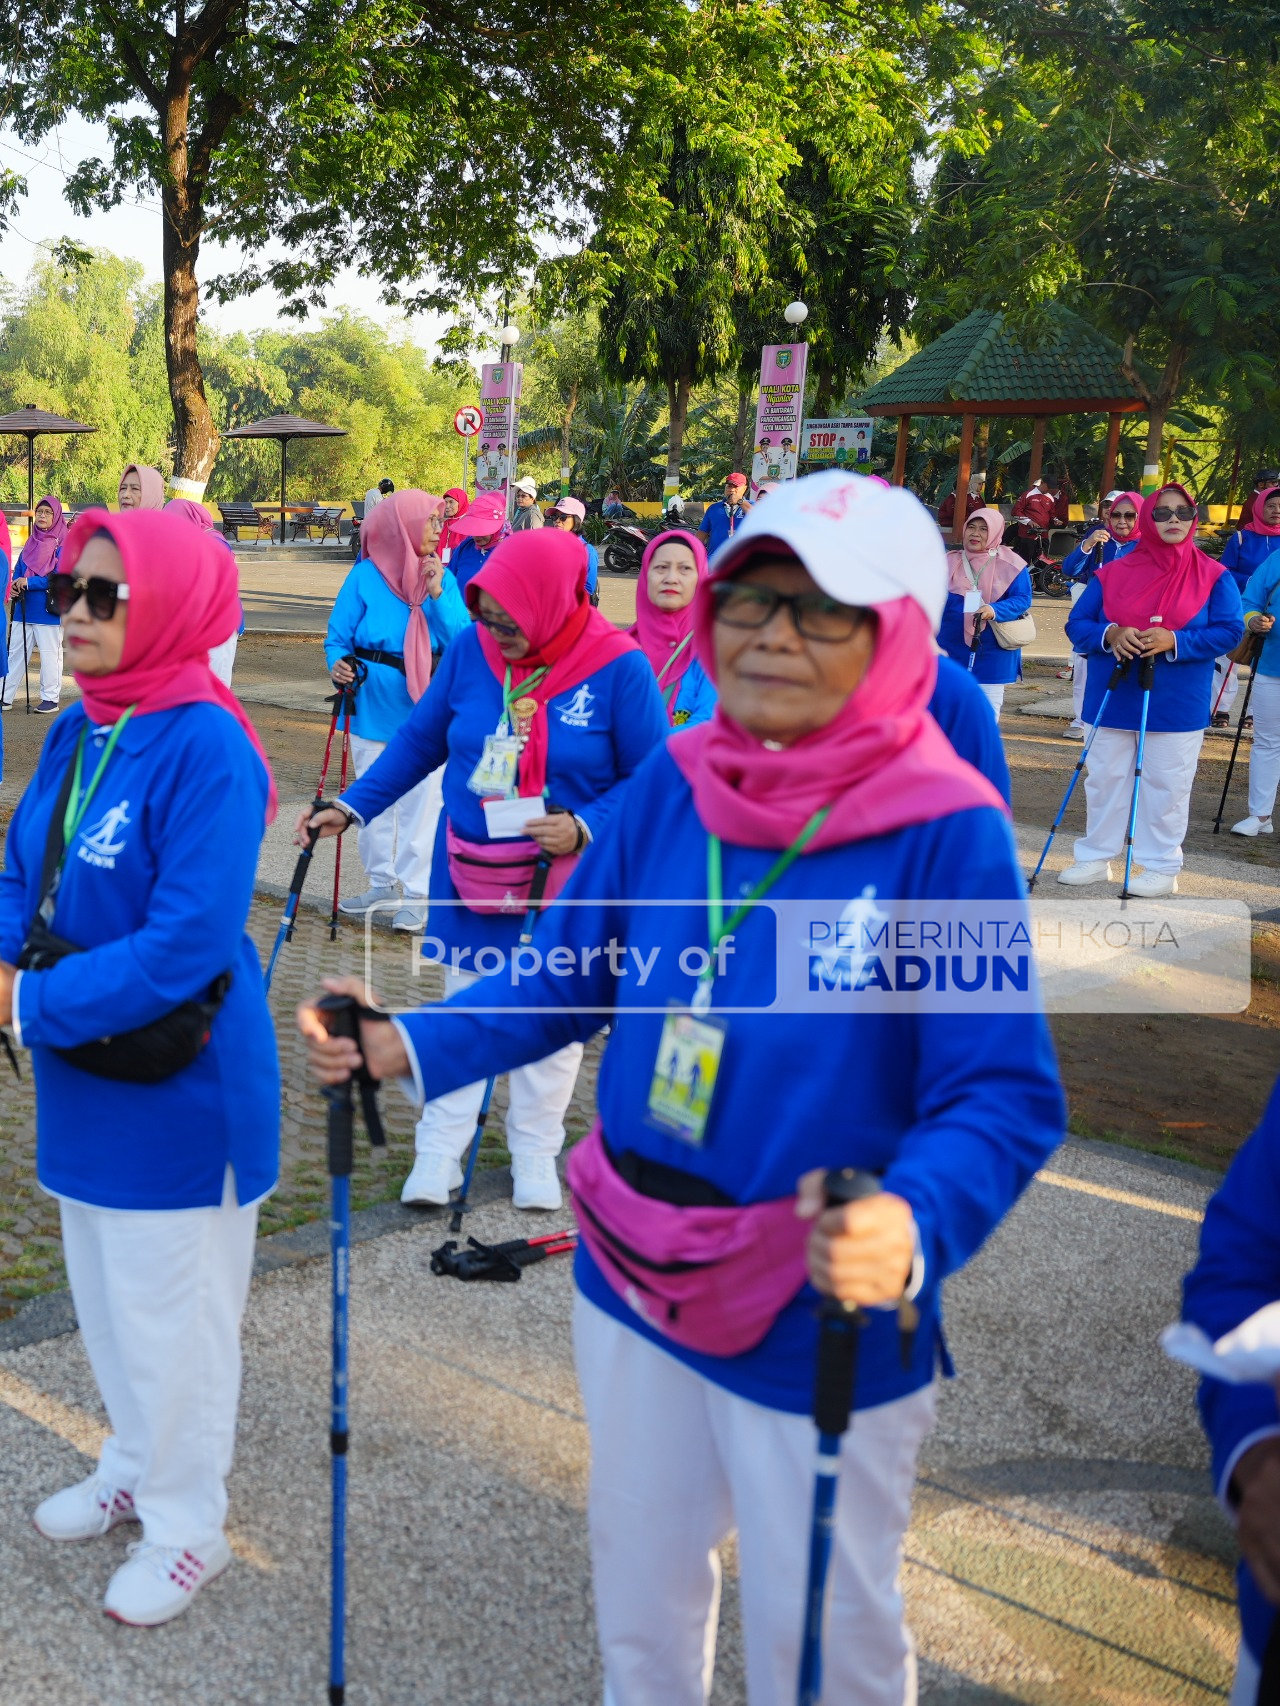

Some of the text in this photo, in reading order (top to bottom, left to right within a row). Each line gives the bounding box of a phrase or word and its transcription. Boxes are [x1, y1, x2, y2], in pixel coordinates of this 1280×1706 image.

[761, 384, 800, 394] WALI KOTA
[809, 433, 836, 447] STOP
